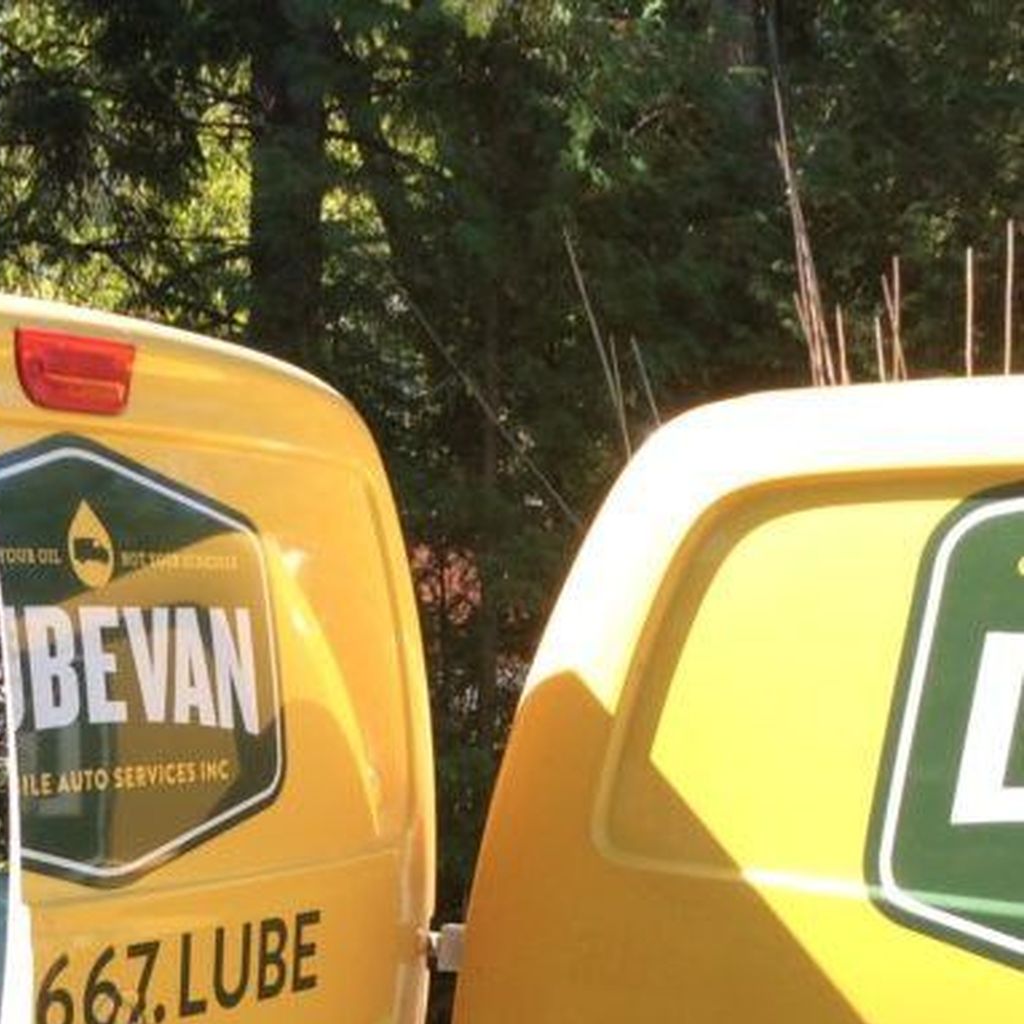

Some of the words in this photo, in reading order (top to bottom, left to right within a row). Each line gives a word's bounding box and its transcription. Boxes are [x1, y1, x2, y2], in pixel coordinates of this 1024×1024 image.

[38, 548, 63, 565] OIL
[57, 768, 110, 794] AUTO
[112, 761, 196, 790] SERVICES
[200, 758, 230, 782] INC
